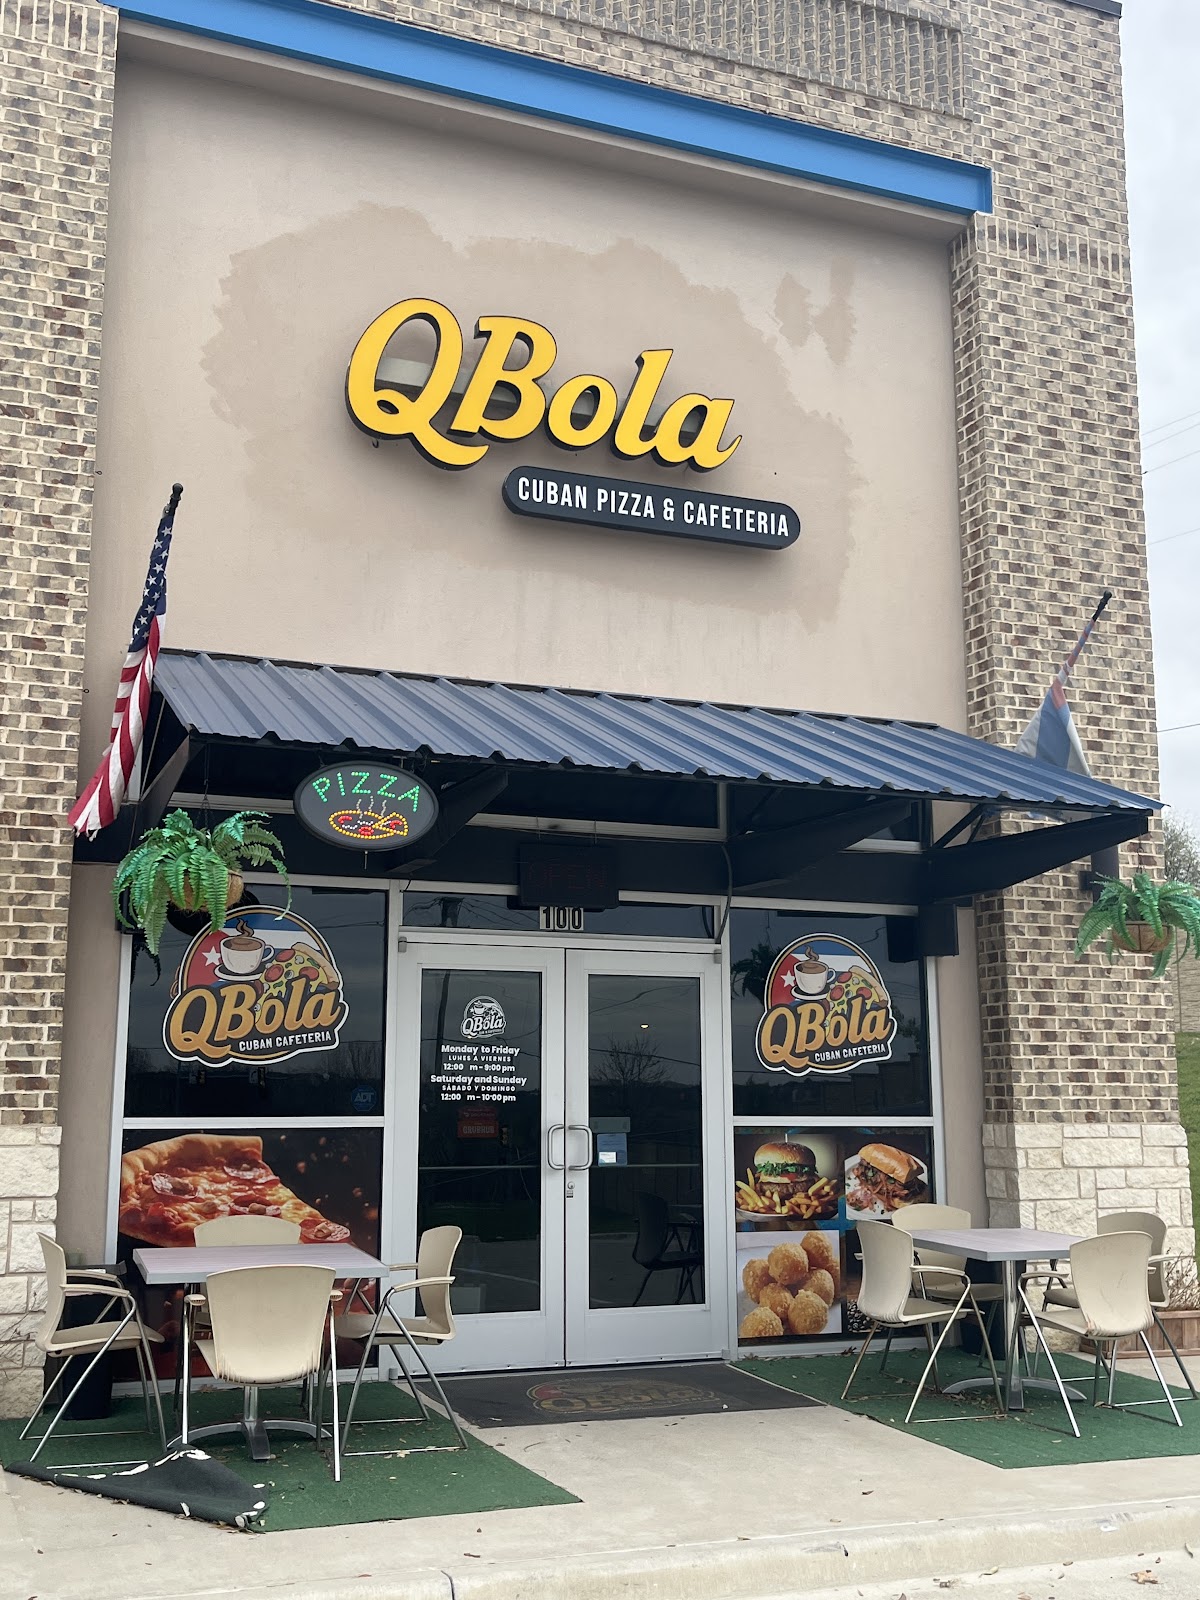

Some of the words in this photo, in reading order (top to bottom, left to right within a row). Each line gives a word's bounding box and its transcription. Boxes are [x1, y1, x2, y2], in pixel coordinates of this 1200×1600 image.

[346, 298, 743, 471] QBola
[517, 477, 588, 509] CUBAN
[597, 489, 656, 519] PIZZA
[663, 501, 675, 521] &
[683, 501, 790, 537] CAFETERIA
[312, 771, 420, 812] PIZZA
[541, 907, 582, 930] 100
[170, 978, 341, 1059] QBola
[462, 1014, 504, 1037] QBola
[239, 1037, 273, 1052] CUBAN
[275, 1030, 332, 1048] CAFETERIA
[761, 996, 892, 1069] QBola
[441, 1044, 478, 1056] Monday
[491, 1045, 520, 1057] Friday
[814, 1050, 841, 1062] CUBAN
[843, 1043, 886, 1058] CAFETERIA
[443, 1063, 464, 1071] 12:00
[501, 1065, 516, 1073] pm
[430, 1074, 473, 1086] Saturday
[474, 1075, 492, 1083] and
[492, 1075, 527, 1086] Sunday
[353, 1092, 375, 1103] ADT
[440, 1093, 461, 1101] 12:00
[502, 1094, 517, 1103] pm
